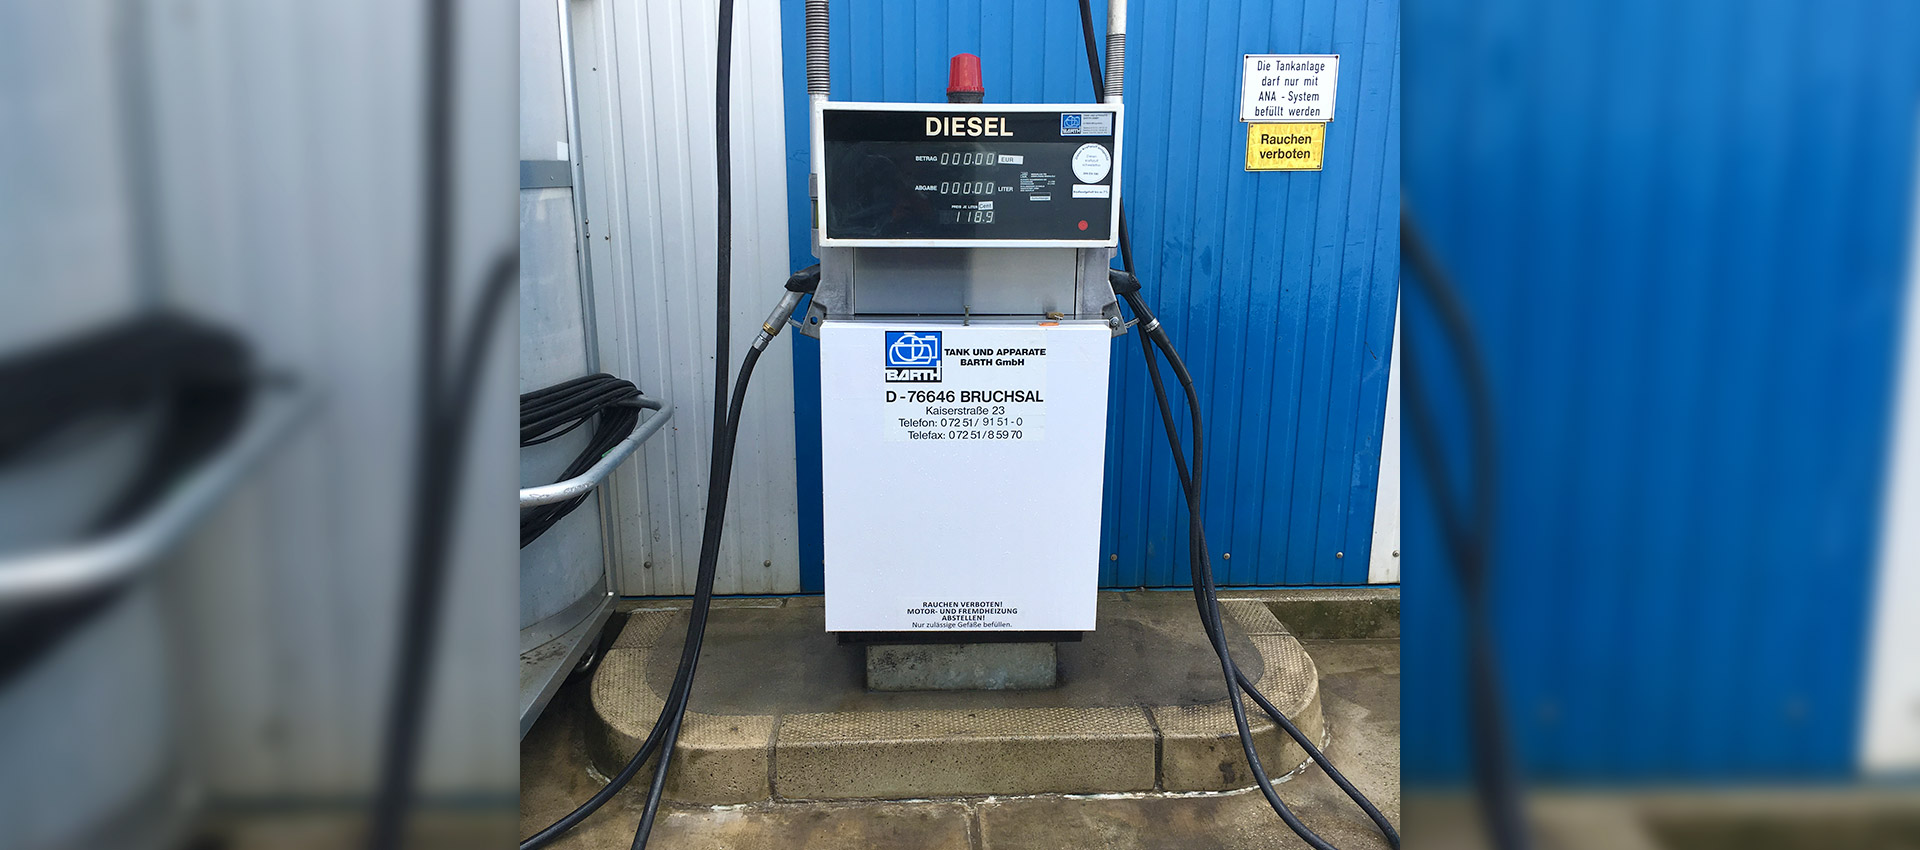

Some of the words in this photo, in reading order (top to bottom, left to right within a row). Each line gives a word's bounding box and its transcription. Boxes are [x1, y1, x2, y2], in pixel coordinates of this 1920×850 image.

[1257, 60, 1271, 71] Die
[1276, 60, 1325, 74] Tankanlage
[1261, 76, 1280, 86] darf
[1284, 78, 1299, 86] nur
[1303, 75, 1318, 86] mit
[1258, 91, 1277, 101] ANA
[1288, 91, 1320, 104] System
[1254, 105, 1283, 116] befüllt
[1288, 106, 1320, 116] werden
[925, 116, 1014, 137] DIESEL
[1260, 134, 1312, 144] Rauchen
[1260, 149, 1311, 159] verboten
[944, 348, 970, 356] TANK
[972, 348, 994, 356] UND
[996, 348, 1047, 356] APPARATE
[960, 358, 993, 366] BARTH
[995, 358, 1025, 366] GmbH
[885, 365, 941, 381] BARTH
[960, 390, 1044, 403] BRUCHSAL
[925, 405, 989, 415] Kaiserstraße
[991, 405, 1005, 415] 23
[899, 418, 938, 427] Telefon:
[907, 430, 946, 439] Telefax:
[926, 621, 956, 629] zulässige
